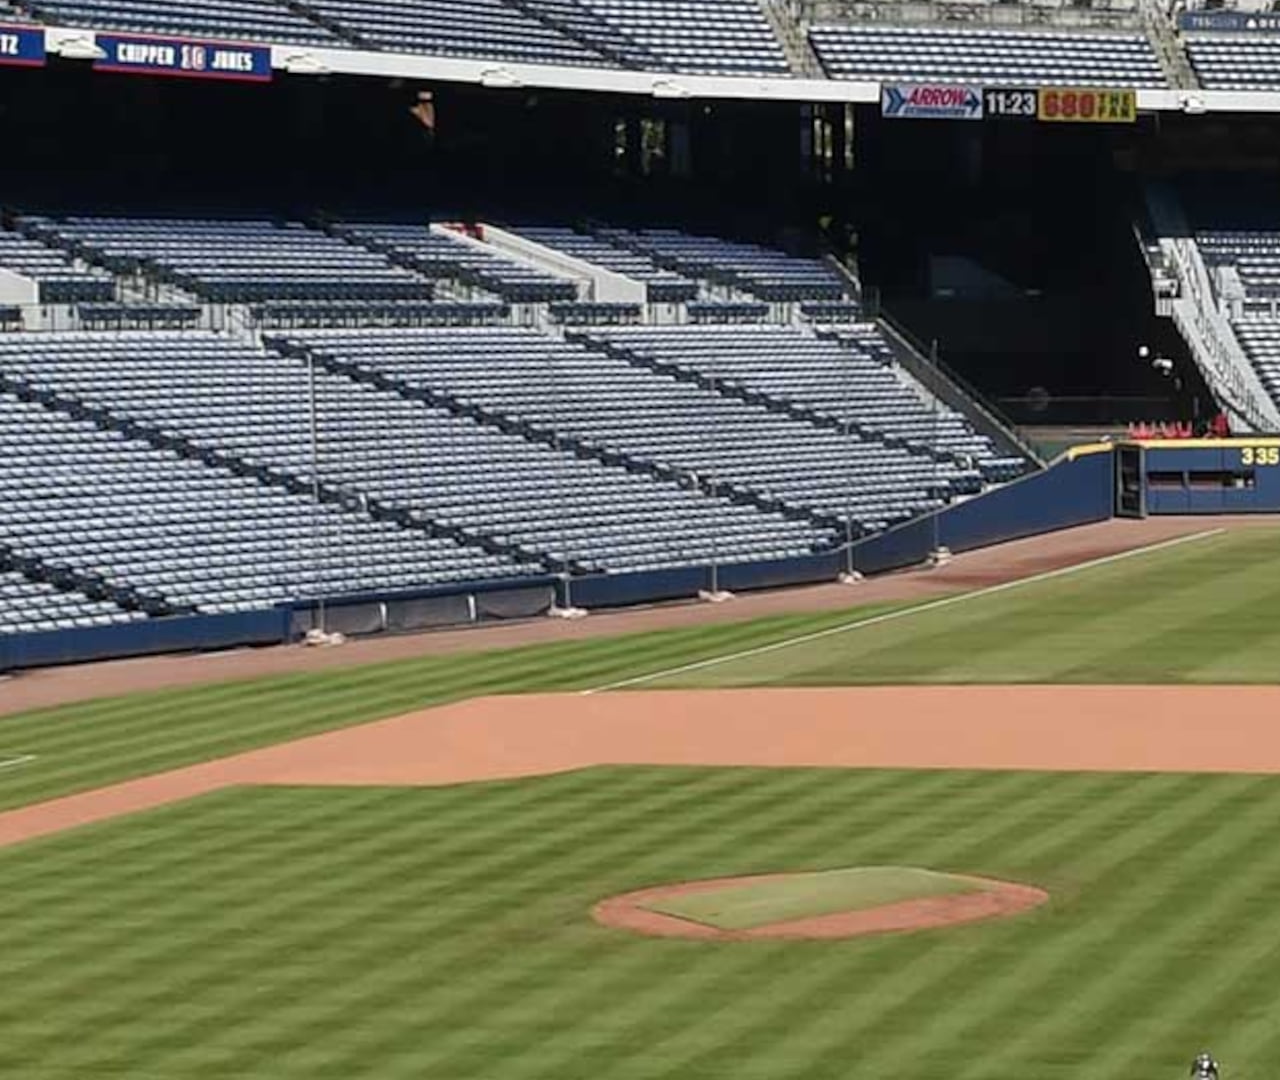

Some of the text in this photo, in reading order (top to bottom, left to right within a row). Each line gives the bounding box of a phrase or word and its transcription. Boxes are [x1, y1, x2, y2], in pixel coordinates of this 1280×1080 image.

[117, 43, 176, 66] CHIPPER
[211, 50, 254, 71] JONES
[907, 87, 967, 106] ARROW
[985, 91, 1036, 115] 11:23
[1241, 447, 1280, 465] 335
